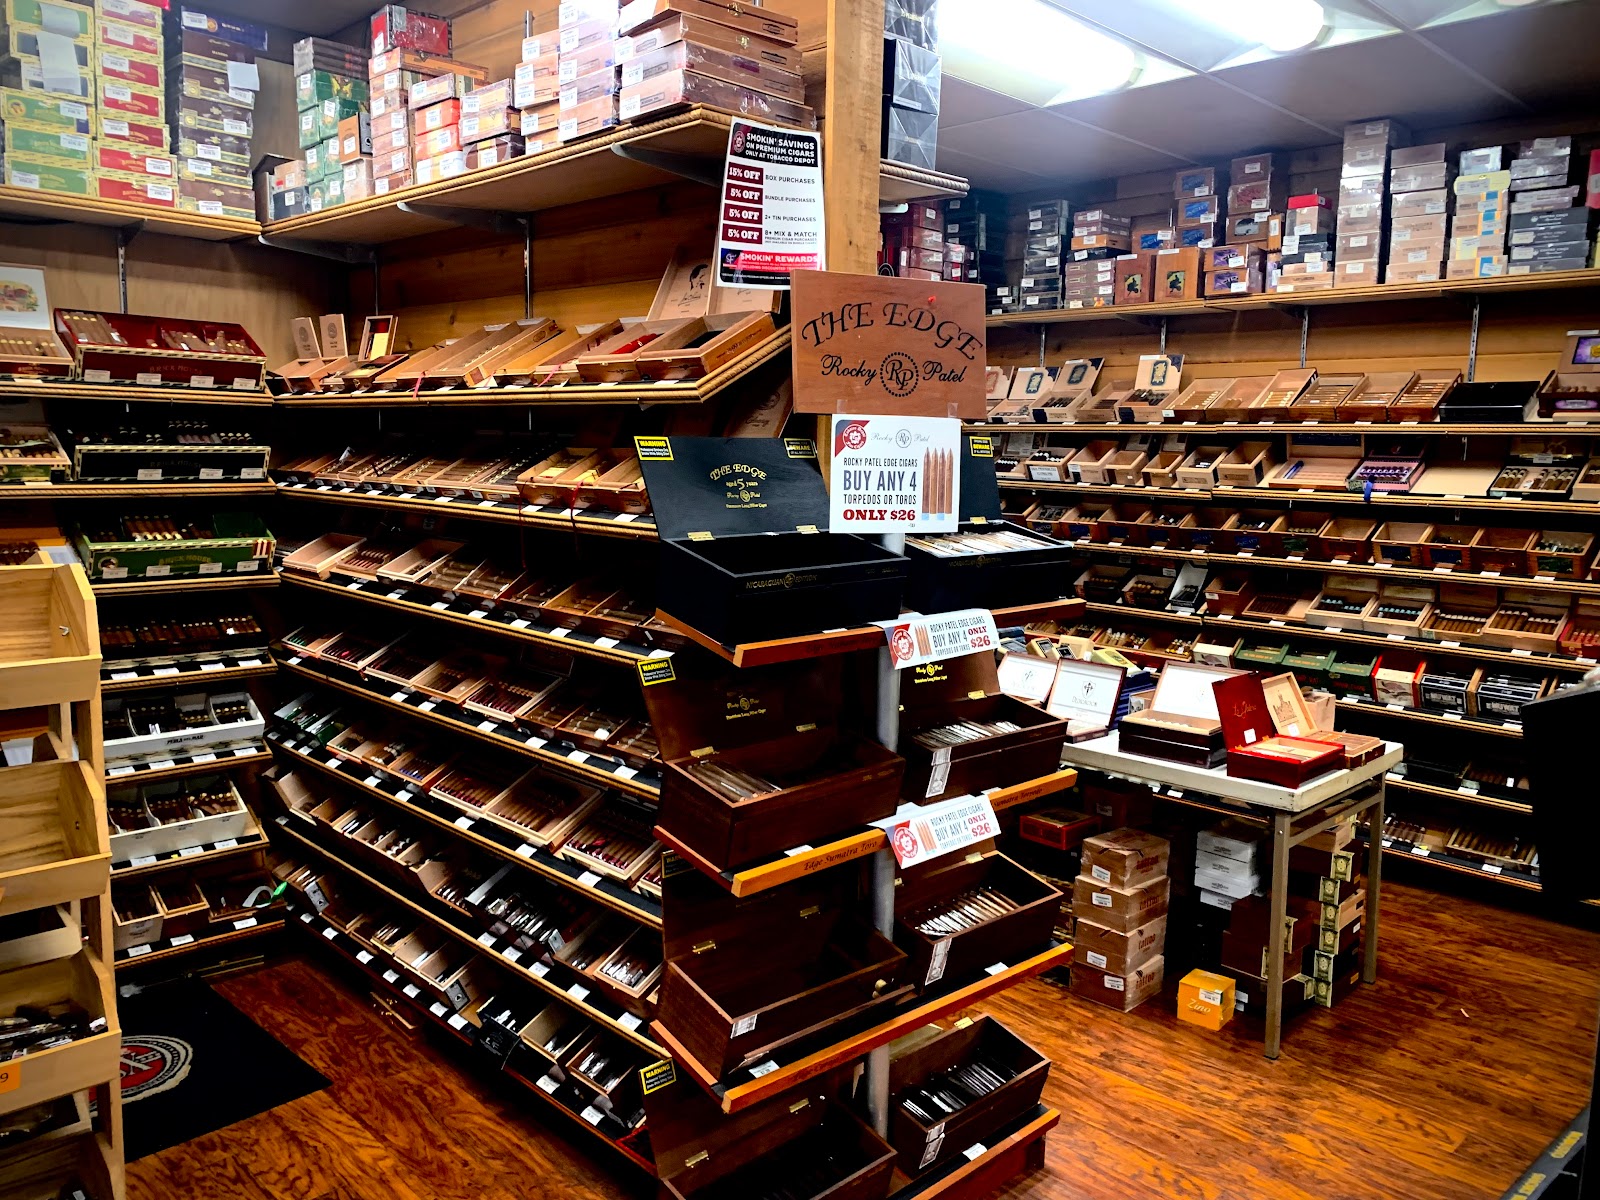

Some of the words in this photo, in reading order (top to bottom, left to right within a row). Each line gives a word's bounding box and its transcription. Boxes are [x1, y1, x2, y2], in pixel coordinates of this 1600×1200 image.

[746, 133, 777, 145] SMOKIN'
[778, 139, 815, 150] SAVINGS
[745, 149, 758, 158] ONLY
[759, 151, 766, 159] AT
[767, 153, 793, 163] TOBACCO
[794, 157, 815, 165] DEPOT
[746, 142, 755, 150] ON
[756, 143, 787, 155] PREMIUM
[788, 148, 815, 158] CIGARS
[728, 166, 743, 177] 15%
[743, 169, 761, 180] OFF
[778, 176, 815, 184] PURCHASES
[730, 188, 742, 198] 5%
[742, 190, 760, 200] OFF
[765, 194, 784, 202] BUNDLE
[785, 196, 816, 204] PURCHASES
[728, 208, 741, 218] 5%
[741, 210, 760, 220] OFF
[727, 228, 740, 238] 5%
[740, 230, 760, 240] OFF
[740, 253, 774, 263] SMOKIN'
[775, 255, 818, 263] REWARDS
[801, 301, 875, 347] THE
[882, 302, 984, 361] EDGE
[820, 354, 877, 386] Rocky
[922, 360, 968, 383] Patel
[843, 457, 862, 466] ROCKY
[864, 457, 882, 467] PATEL
[883, 458, 898, 467] EDGE
[898, 458, 918, 468] CIGARS
[709, 464, 733, 481] THE
[732, 463, 768, 481] EDGE
[737, 478, 746, 491] 5
[843, 469, 872, 491] BUY
[877, 470, 905, 491] ANY
[909, 471, 917, 492] 4
[843, 493, 881, 505] TORPEDOS
[883, 494, 893, 505] OR
[895, 494, 917, 505] TOROS
[842, 508, 888, 521] ONLY
[890, 509, 916, 521] $26
[930, 622, 946, 633] ROCKY
[945, 619, 959, 631] PATEL
[959, 617, 969, 629] EDGE
[968, 615, 986, 627] CIGARS
[967, 625, 988, 636] ONLY
[932, 633, 947, 649] BUY
[948, 631, 962, 645] ANY
[962, 629, 968, 642] 4
[970, 634, 991, 649] $26
[935, 646, 954, 657] TORPEDOS
[954, 645, 960, 653] OR
[642, 661, 669, 671] WARNING
[930, 815, 946, 828] ROCKY
[945, 812, 959, 823] PATEL
[959, 808, 968, 819] EDGE
[967, 803, 984, 816] CIGARS
[967, 812, 987, 825] ONLY
[934, 826, 949, 841] BUY
[950, 823, 963, 838] ANY
[963, 820, 969, 832] 4
[971, 822, 992, 838] $26
[803, 858, 824, 871] Edge
[824, 847, 859, 864] Sumatra
[860, 841, 878, 852] Toro
[1187, 999, 1212, 1014] Zino
